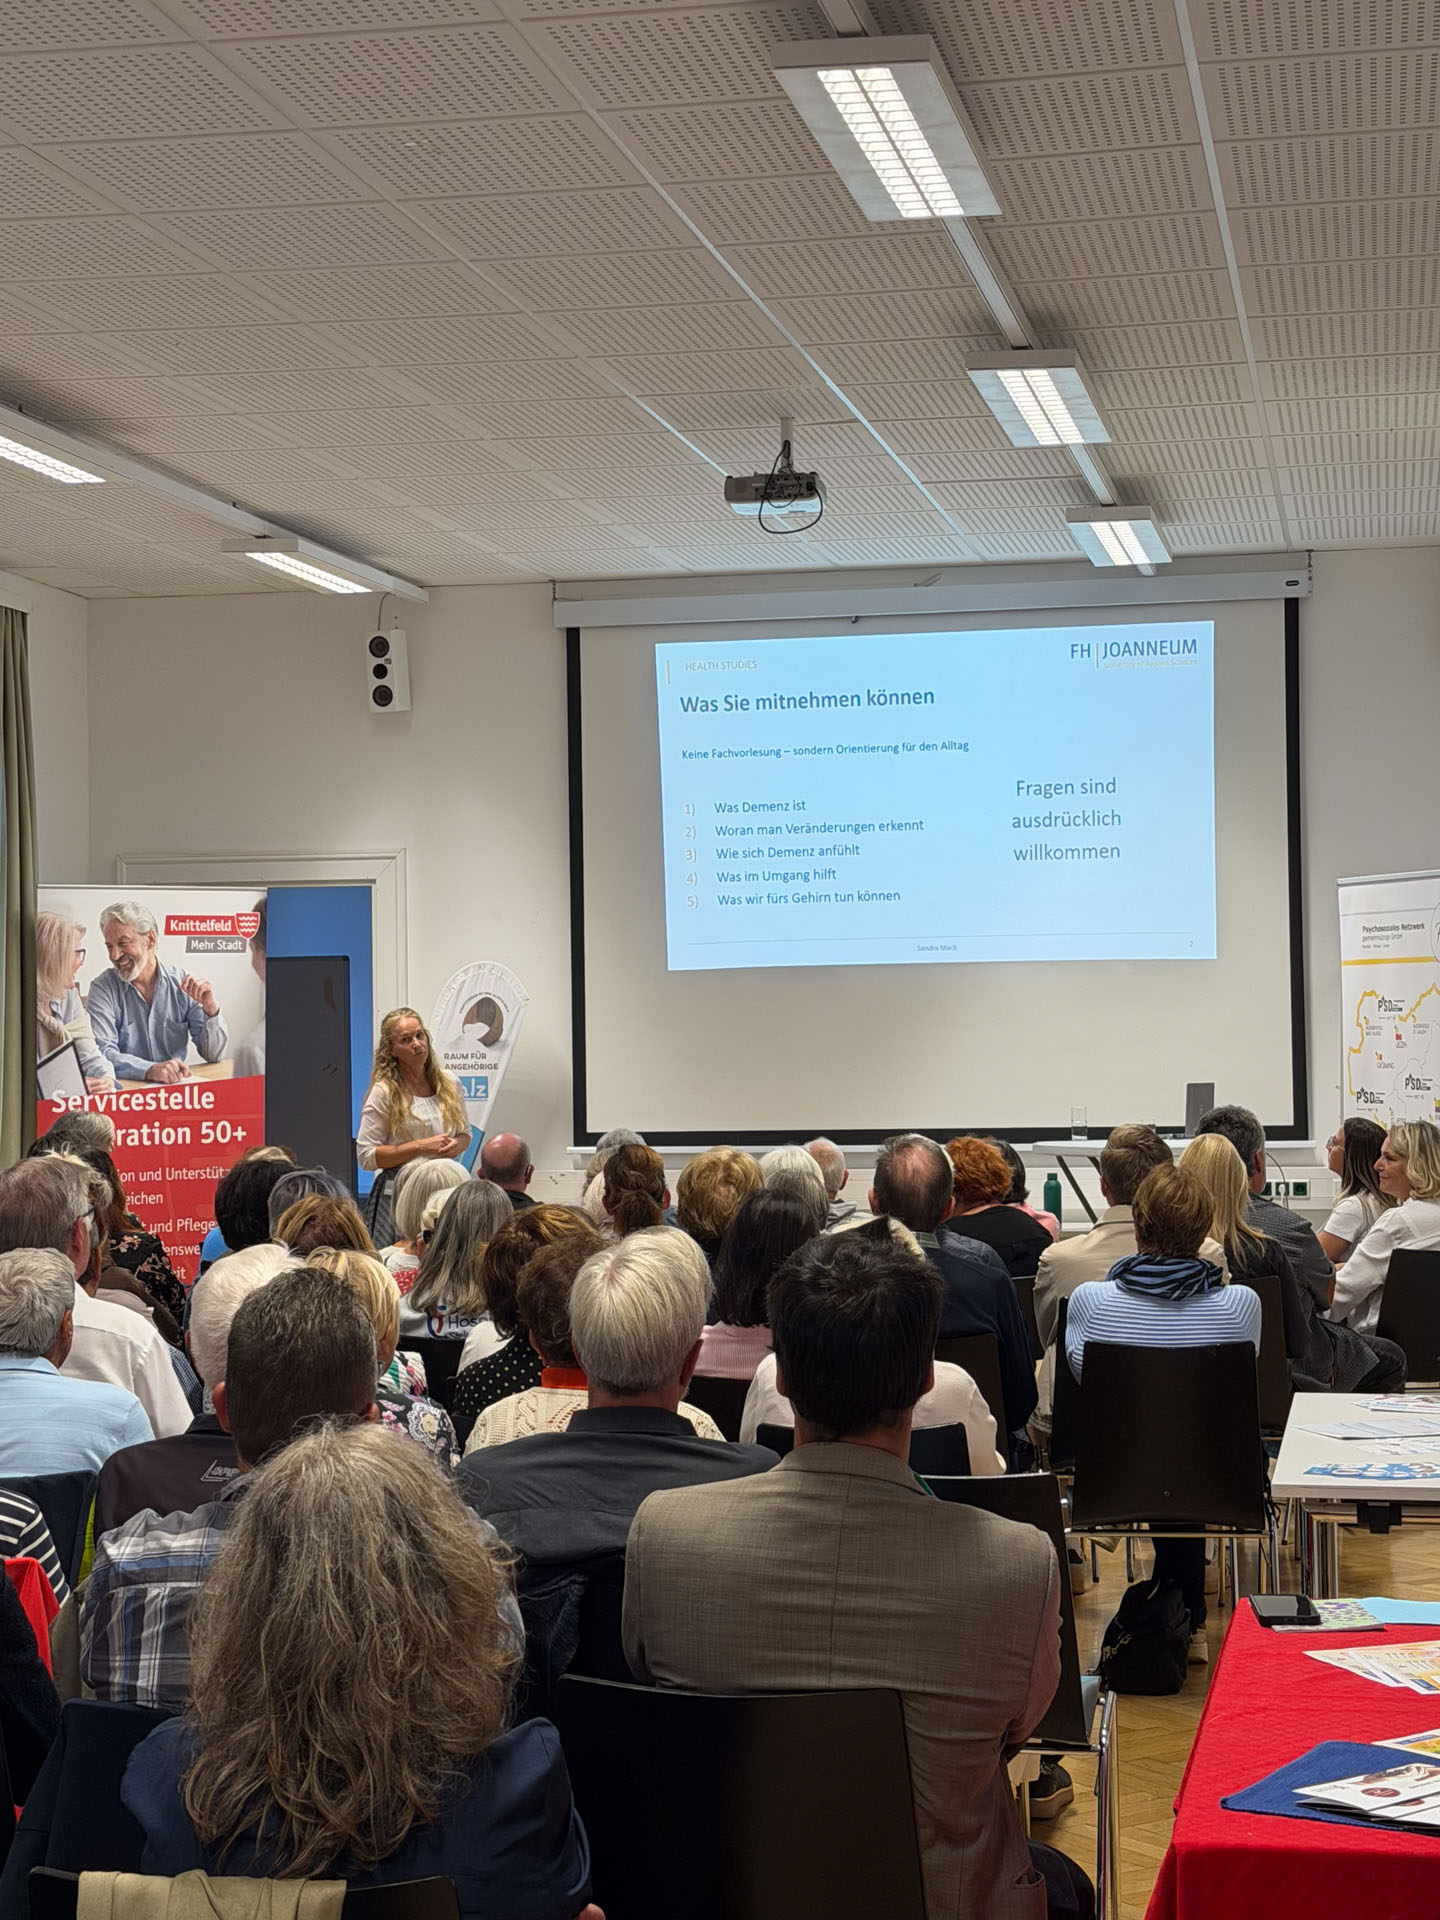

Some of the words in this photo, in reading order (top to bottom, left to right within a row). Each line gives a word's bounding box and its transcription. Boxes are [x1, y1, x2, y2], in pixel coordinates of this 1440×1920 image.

[1070, 643, 1091, 659] FH
[1102, 638, 1197, 659] JOANNEUM
[685, 661, 718, 672] HEALTH
[721, 660, 758, 671] STUDIES
[679, 695, 719, 713] Was
[723, 693, 750, 712] Sie
[755, 690, 861, 710] mitnehmen
[866, 688, 935, 706] können
[681, 749, 709, 760] Keine
[711, 747, 782, 759] Fachvorlesung
[793, 745, 833, 756] sondern
[836, 743, 900, 755] Orientierung
[901, 741, 916, 752] für
[918, 741, 938, 752] den
[940, 740, 970, 752] Alltag
[1016, 779, 1075, 799] Fragen
[1080, 776, 1116, 795] sind
[684, 802, 696, 817] 1)
[714, 802, 739, 813] Was
[742, 801, 790, 813] Demenz
[792, 800, 807, 811] ist
[1011, 808, 1121, 829] ausdrücklich
[684, 825, 697, 839] 2)
[714, 825, 754, 836] Woran
[757, 825, 783, 835] man
[785, 821, 875, 835] Veränderungen
[878, 819, 924, 832] erkennt
[685, 848, 697, 862] 3)
[715, 847, 739, 859] Wie
[742, 846, 765, 859] sich
[767, 846, 815, 858] Demenz
[818, 844, 861, 857] anfühlt
[1013, 843, 1121, 861] willkommen
[686, 871, 698, 886] 4)
[716, 871, 742, 883] Was
[744, 870, 759, 881] im
[762, 870, 810, 884] Umgang
[813, 867, 837, 880] hilft
[687, 894, 699, 909] 5)
[717, 894, 743, 906] Was
[744, 892, 764, 905] wir
[767, 892, 789, 904] fürs
[791, 891, 831, 904] Gehirn
[834, 892, 854, 903] tun
[857, 890, 901, 902] können
[170, 918, 233, 932] Knittelfeld
[191, 939, 215, 950] Mehr
[216, 939, 243, 950] Stadt
[443, 1052, 469, 1061] RAUM
[470, 1050, 487, 1060] FÜR
[444, 1060, 500, 1071] ANGEHÖRIGE
[51, 1085, 215, 1113] Servicestelle
[114, 1121, 191, 1147] ration
[200, 1120, 247, 1144] 50+
[139, 1167, 162, 1182] und
[165, 1165, 232, 1181] Unterstütz
[125, 1191, 164, 1206] eichen
[149, 1218, 173, 1234] und
[176, 1217, 217, 1235] Pflege
